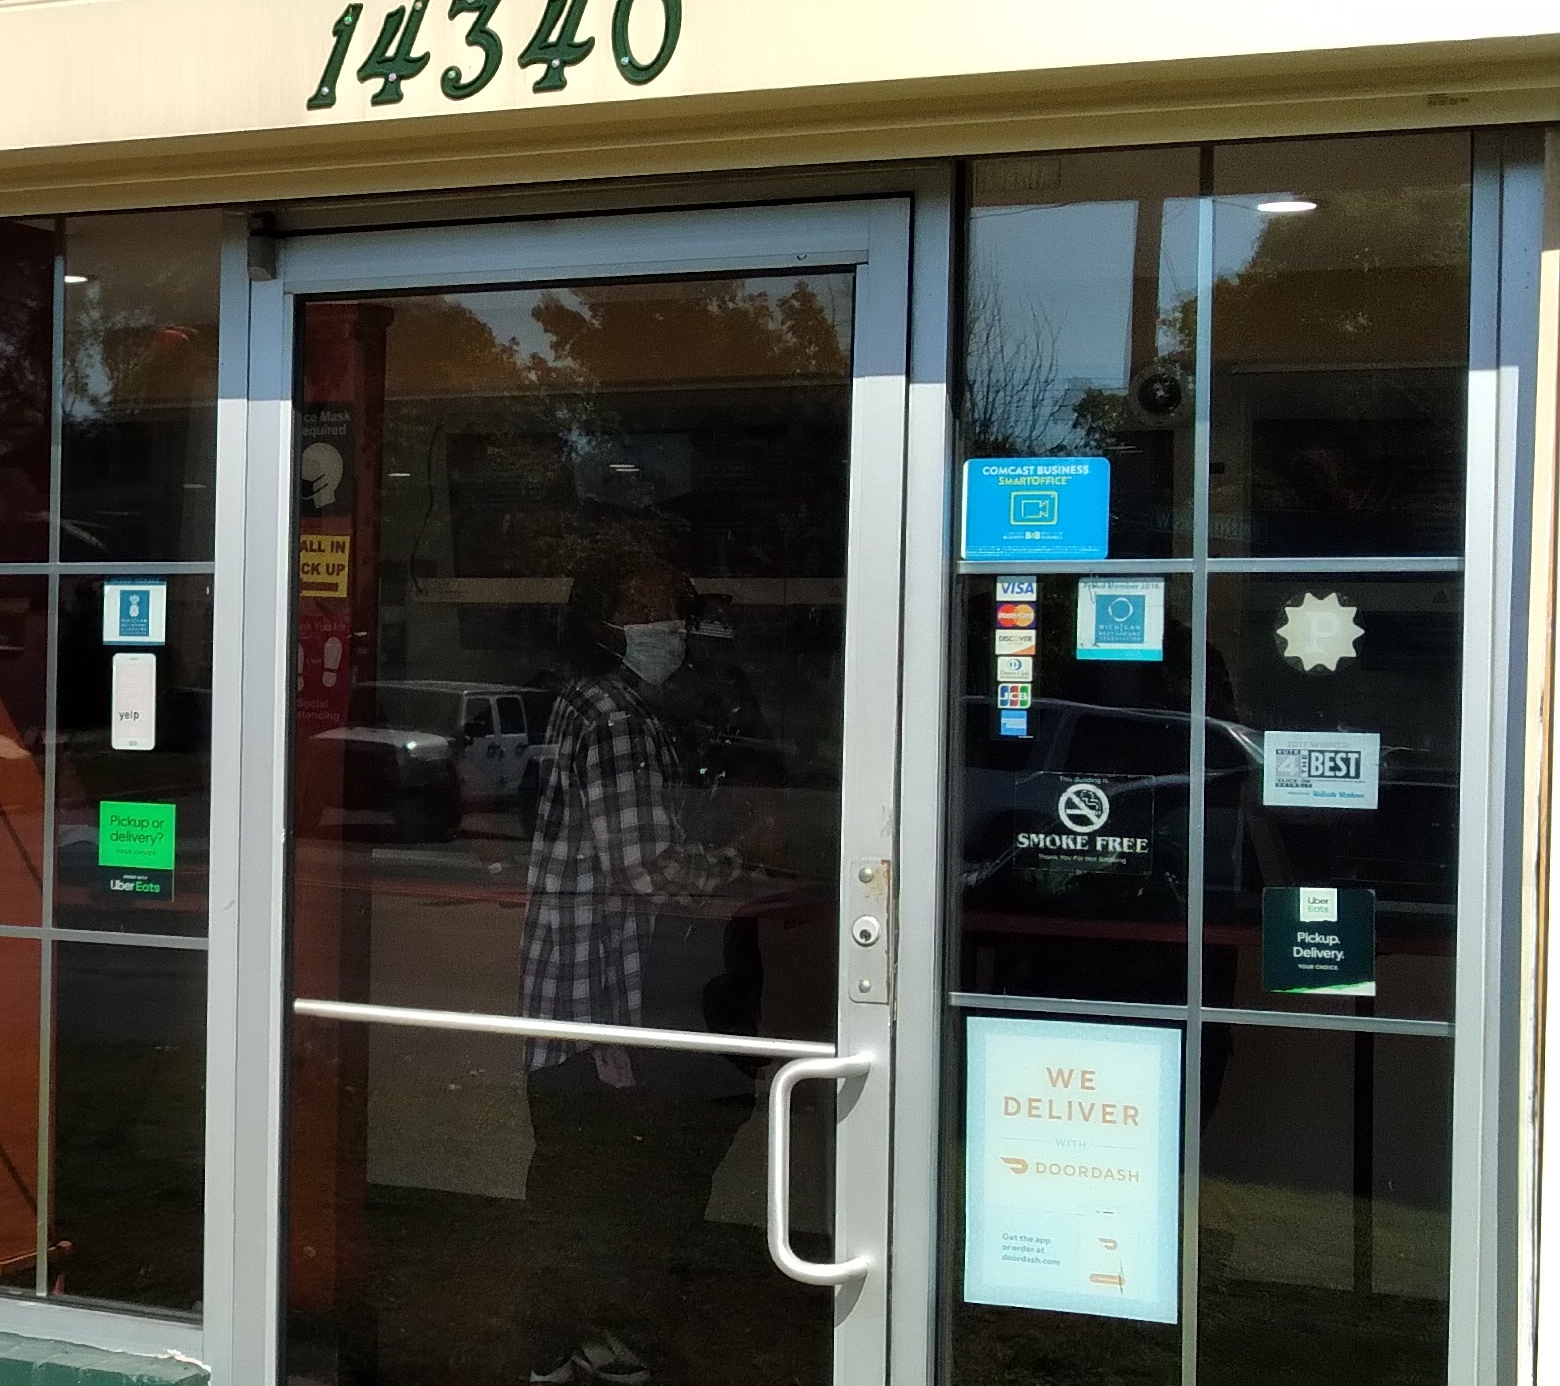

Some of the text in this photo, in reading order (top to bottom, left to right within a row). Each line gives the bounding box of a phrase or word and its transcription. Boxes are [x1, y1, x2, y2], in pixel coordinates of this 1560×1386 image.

[303, 410, 351, 423] ce Mask
[302, 424, 347, 437] equired
[982, 465, 1089, 475] COMCAST BUSINESS
[300, 539, 346, 553] ALL IN
[301, 562, 345, 575] CK UP
[1001, 581, 1034, 594] VISA
[119, 710, 140, 721] yelp
[1310, 751, 1359, 777] BEST
[110, 815, 165, 830] Pickup or
[110, 830, 164, 846] delivery?
[1017, 833, 1149, 853] SMOKE FREE
[110, 879, 160, 892] Uber Eats
[1307, 897, 1329, 905] Uber
[1307, 905, 1329, 913] Eats
[1297, 931, 1341, 946] Pickup.
[1292, 946, 1345, 961] Delivery.
[1046, 1066, 1096, 1091] WE
[1003, 1095, 1139, 1126] DELIVER
[1055, 1138, 1087, 1149] WITH
[1035, 1161, 1140, 1182] DOORDASH
[1002, 1233, 1051, 1245] Get the app
[1012, 1244, 1034, 1253] order
[1002, 1253, 1061, 1266] doordash.com
